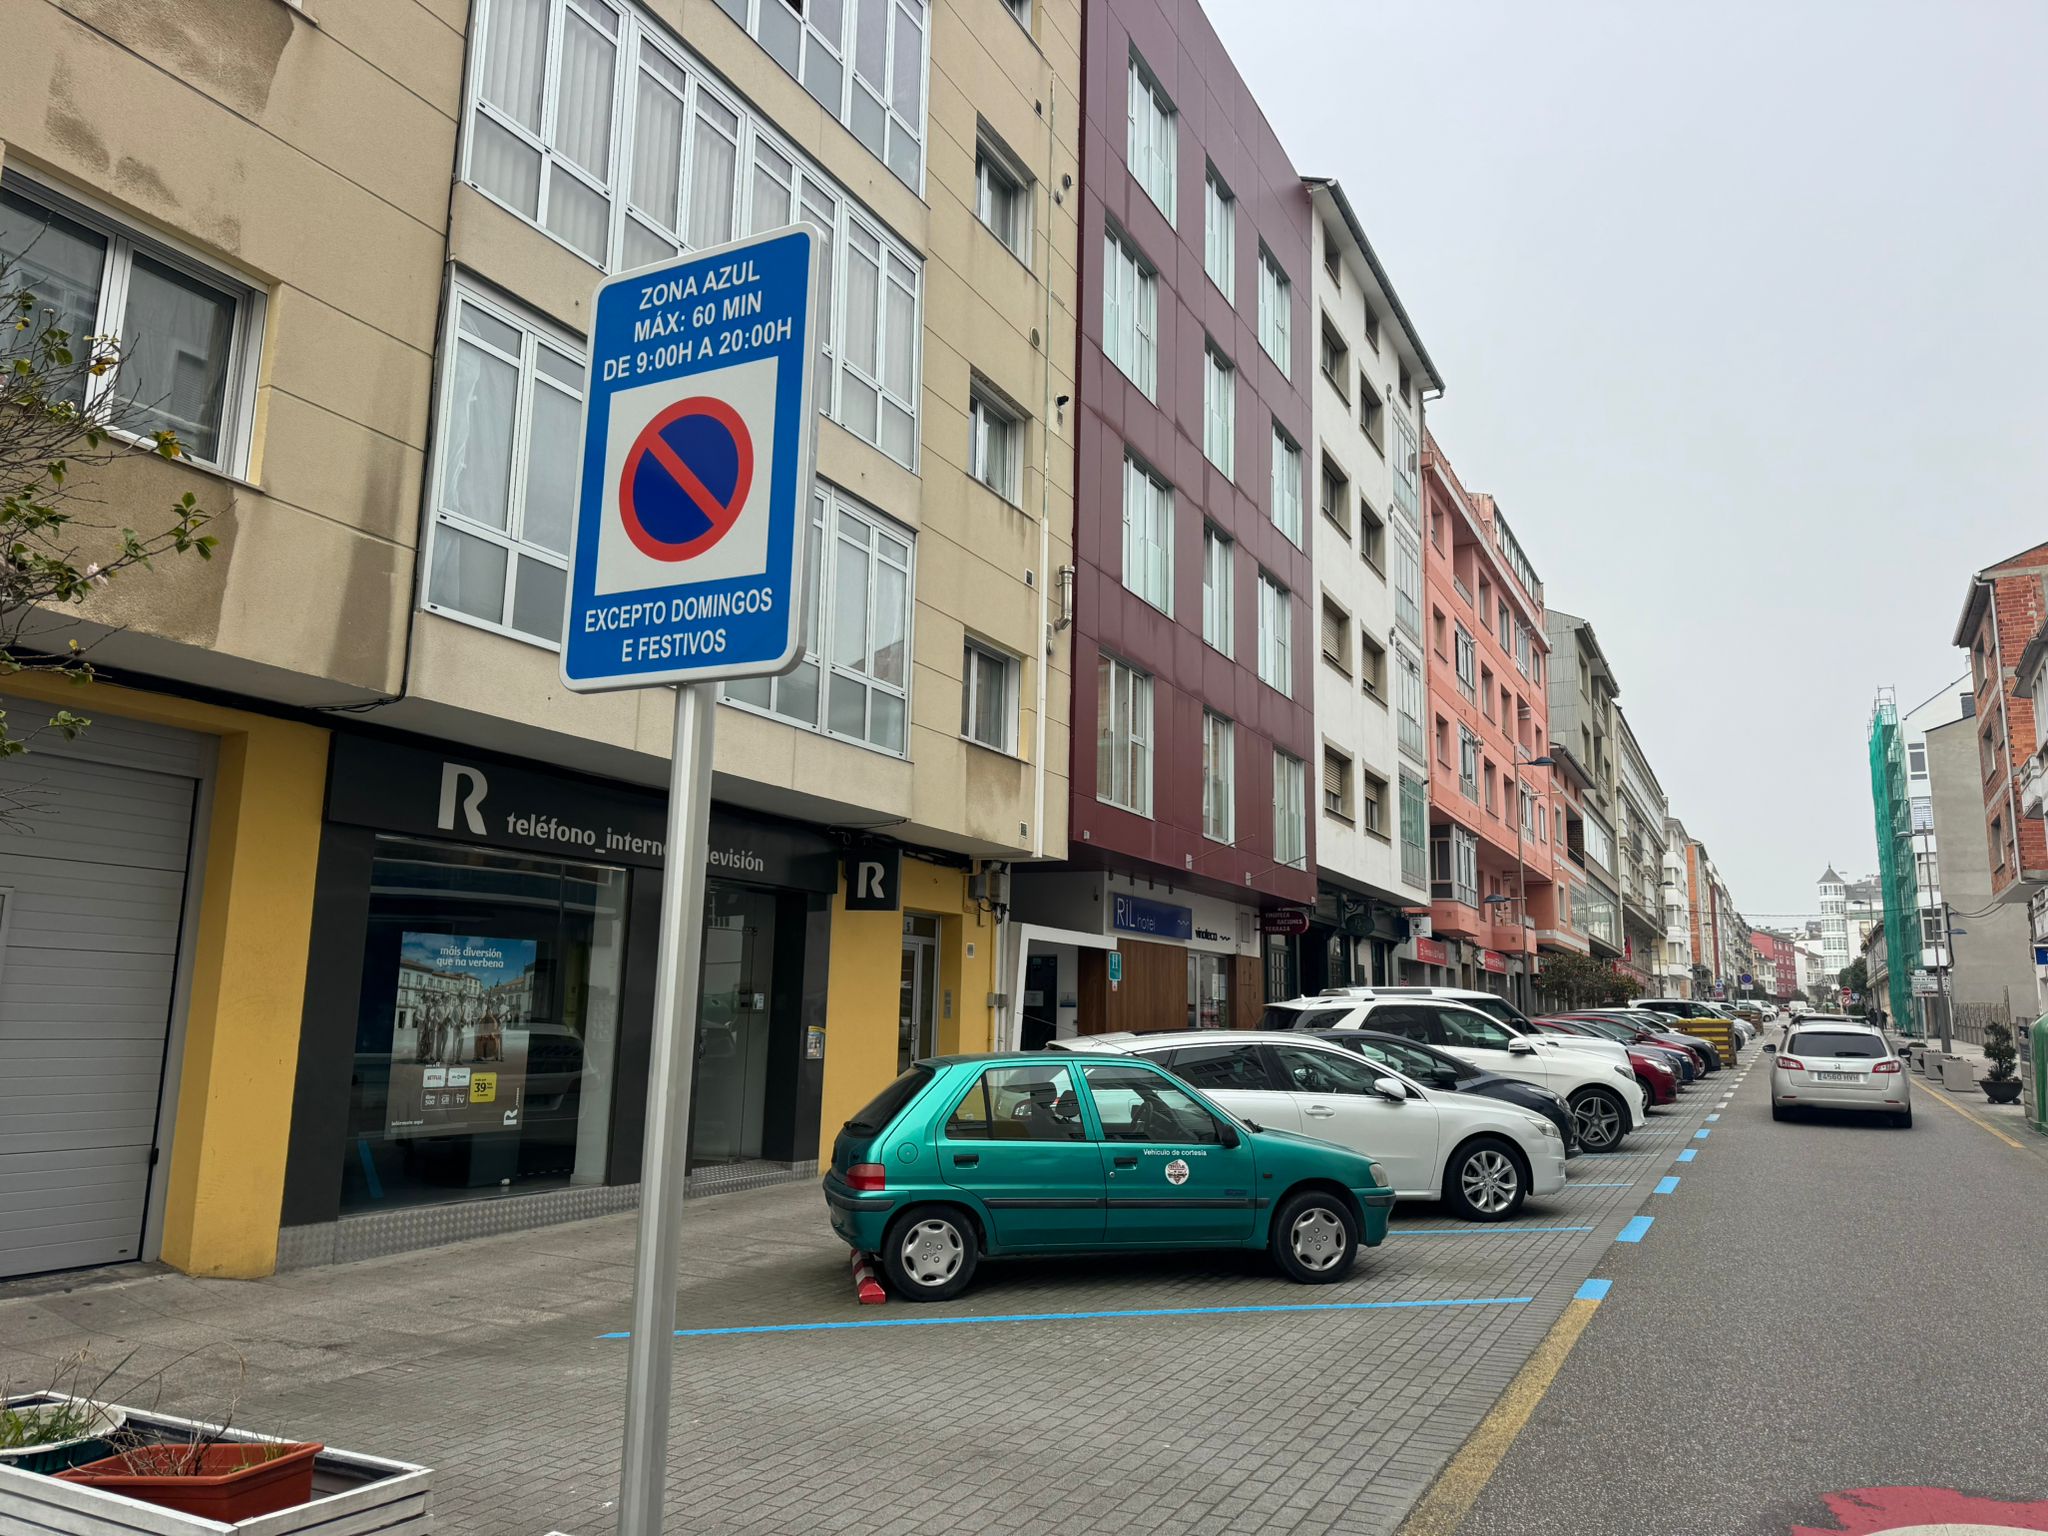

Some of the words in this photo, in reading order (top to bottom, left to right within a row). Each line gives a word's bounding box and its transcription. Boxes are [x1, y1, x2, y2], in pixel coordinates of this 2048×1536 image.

[639, 276, 698, 310] ZONA
[702, 260, 761, 295] AZUL
[634, 311, 686, 343] MÁX:
[692, 303, 716, 329] 60
[722, 291, 762, 321] MIN
[603, 355, 631, 381] DE
[636, 342, 692, 374] 9:00H
[697, 337, 714, 360] A
[719, 317, 792, 355] 20:00H
[584, 601, 667, 633] EXCEPTO
[671, 587, 773, 622] DOMINGOS
[621, 639, 634, 662] E
[638, 629, 727, 661] FESTIVOS
[437, 762, 488, 836] R
[857, 862, 885, 898] R
[906, 921, 911, 932] 5
[1137, 916, 1156, 931] hotel
[436, 958, 453, 967] que
[455, 958, 467, 966] na
[468, 958, 504, 968] verbena
[440, 945, 461, 956] máis
[463, 947, 502, 959] diversión
[1112, 954, 1118, 969] H
[474, 1082, 487, 1092] 39
